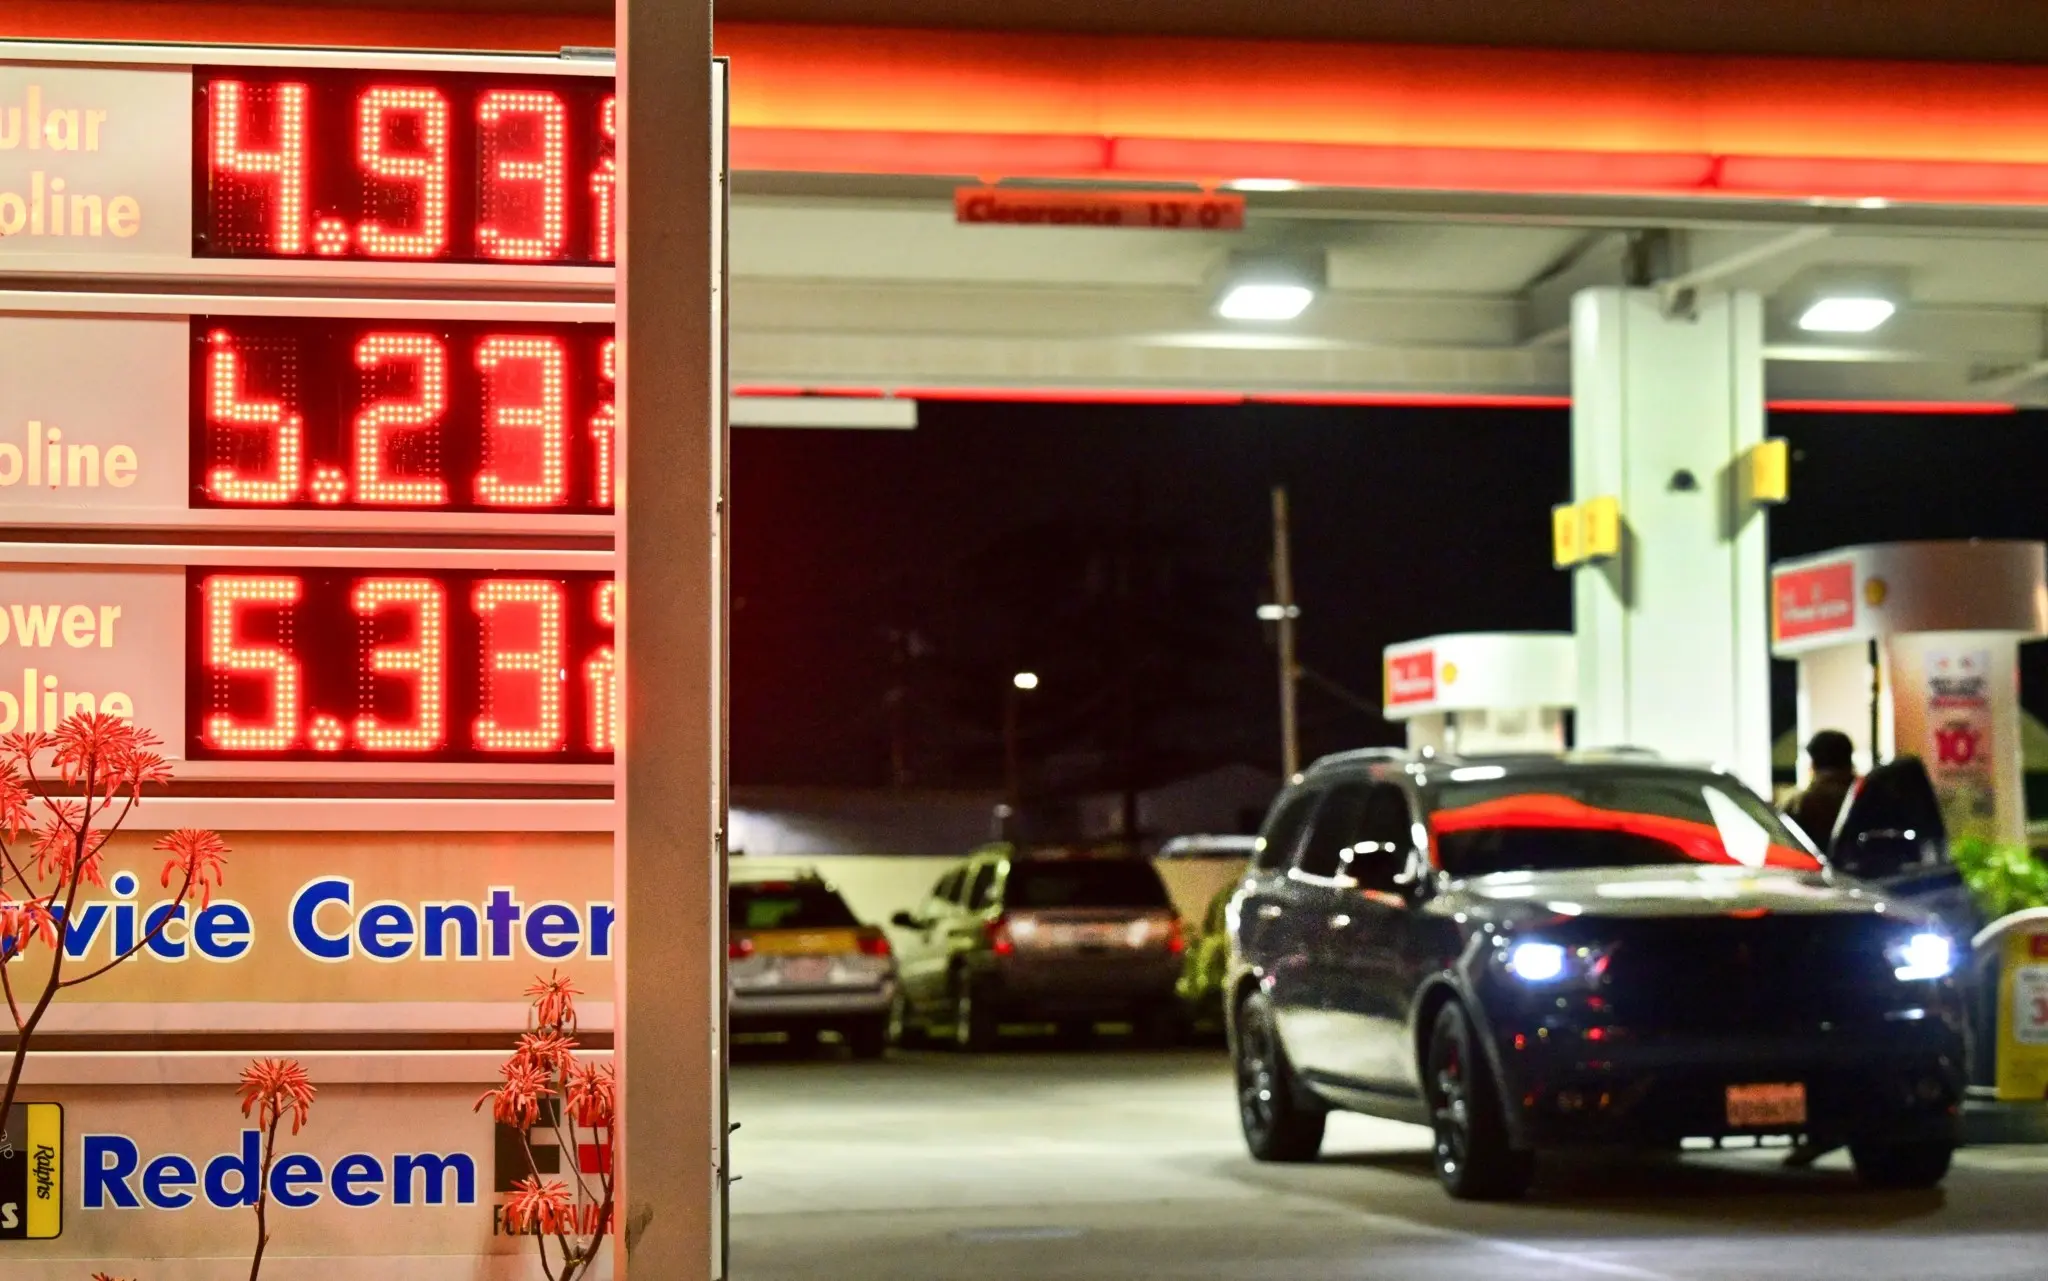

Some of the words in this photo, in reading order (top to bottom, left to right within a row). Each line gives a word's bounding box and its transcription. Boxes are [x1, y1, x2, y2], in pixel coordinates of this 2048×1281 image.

[0, 171, 141, 238] oline
[212, 79, 563, 259] 4.93
[0, 421, 138, 488] oline
[208, 330, 563, 505] 5.23
[206, 576, 563, 753] 5.33
[0, 870, 255, 963] vice
[33, 1144, 55, 1201] Ralphs
[81, 1129, 477, 1209] Redeem
